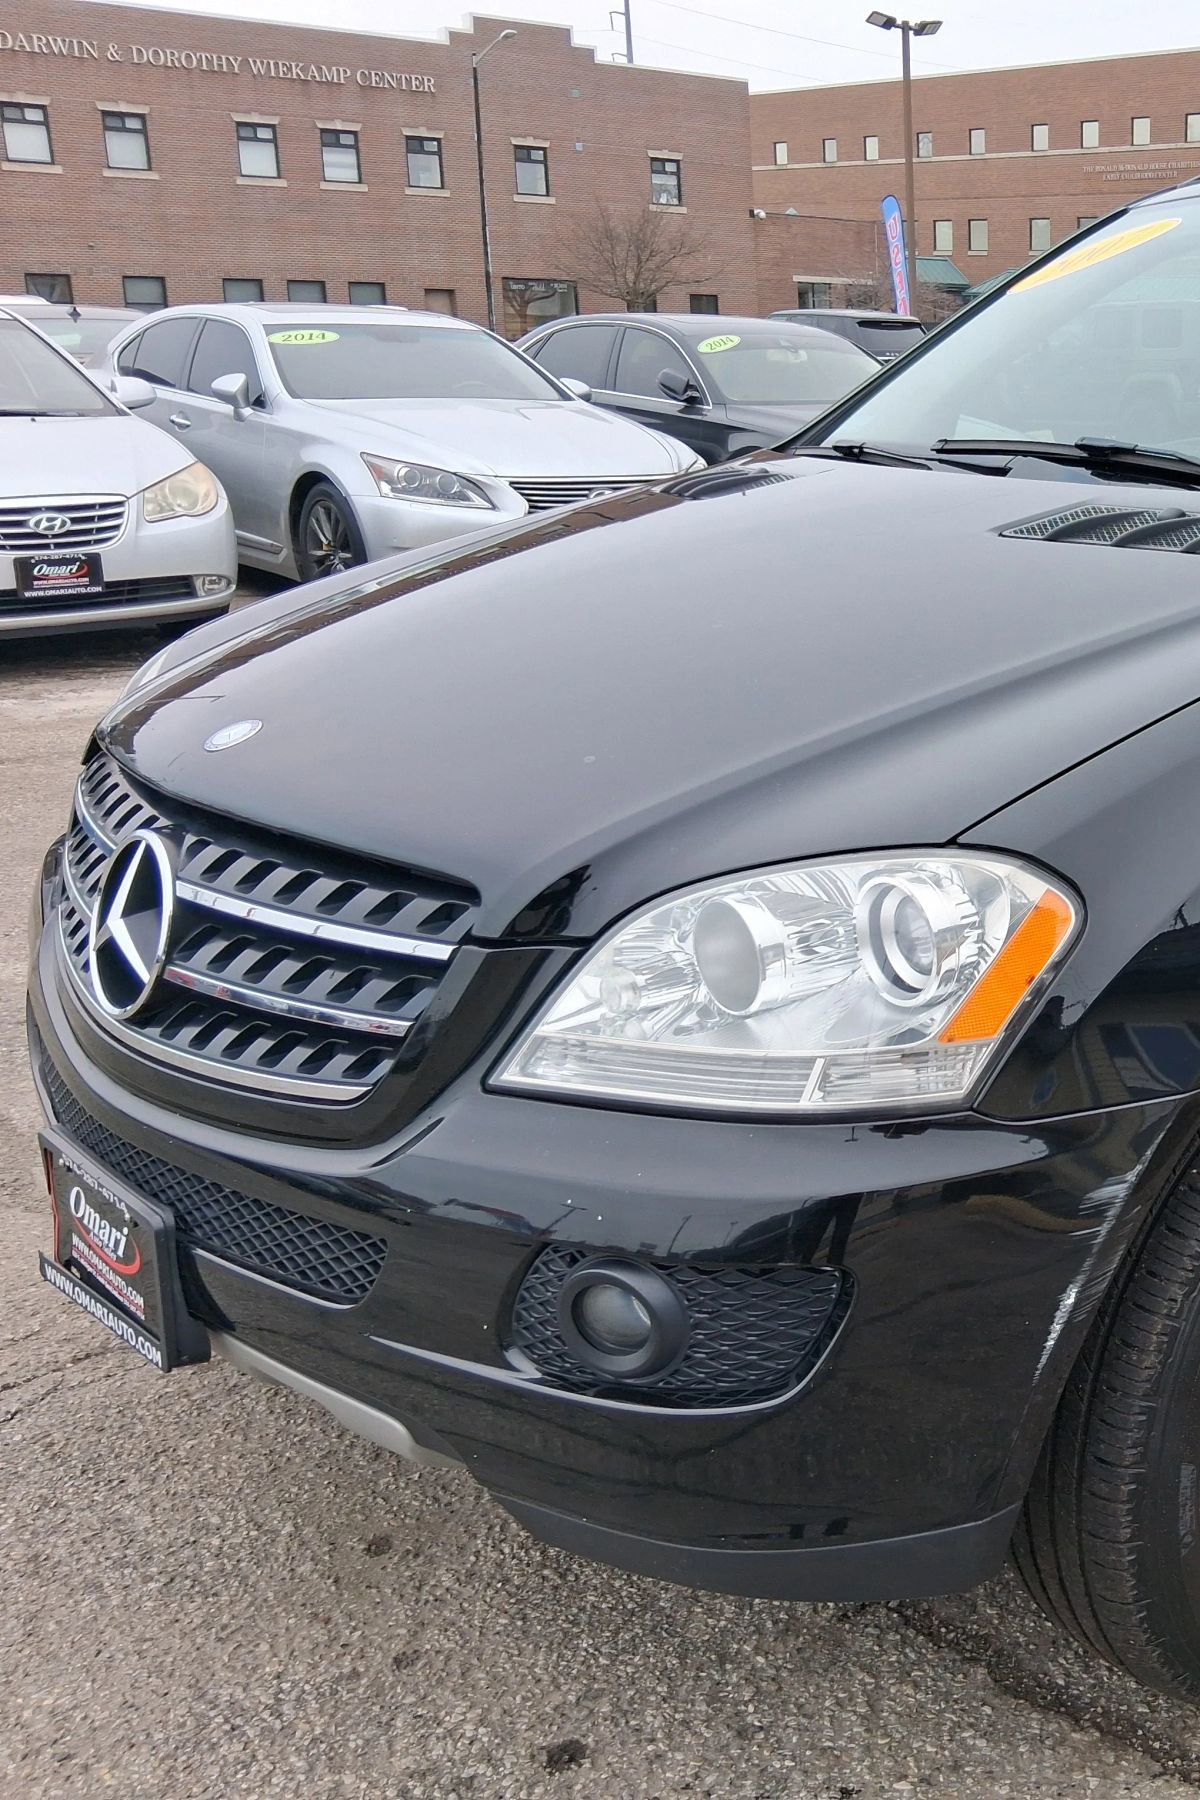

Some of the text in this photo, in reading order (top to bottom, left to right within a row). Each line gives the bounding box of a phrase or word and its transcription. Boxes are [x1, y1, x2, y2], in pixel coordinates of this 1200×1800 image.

[0, 31, 436, 92] DARWIN & DOROTHY WIEKAMP CENTER
[281, 332, 326, 342] 2014
[705, 336, 734, 350] 2014
[33, 562, 80, 576] Omari
[24, 587, 102, 597] WWW.OMARIAUTO.COM
[70, 1187, 128, 1258] Omari
[72, 1232, 144, 1310] WWW.OMARIAUTO.COM
[45, 1263, 161, 1368] WWW.OMARIAUTO.COM
